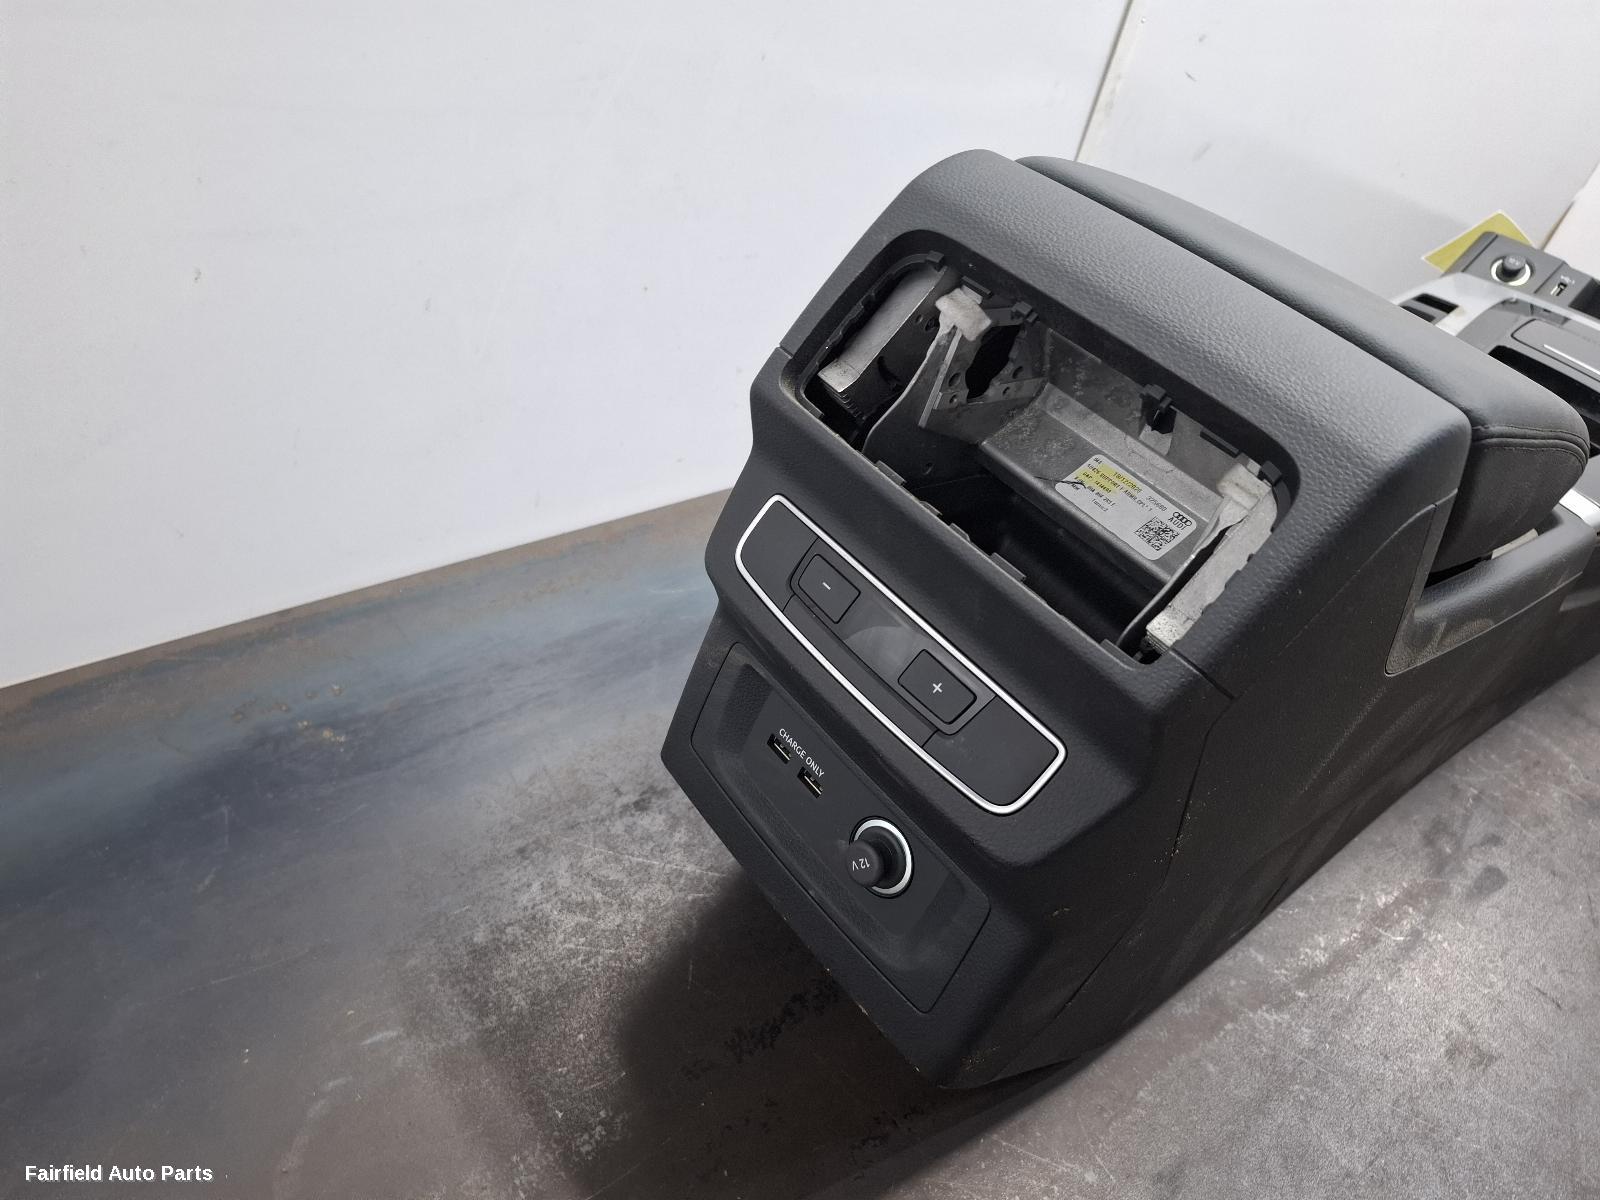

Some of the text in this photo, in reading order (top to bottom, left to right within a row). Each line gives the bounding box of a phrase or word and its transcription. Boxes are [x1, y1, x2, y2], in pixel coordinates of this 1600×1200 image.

[1168, 516, 1188, 531] AUDI
[779, 728, 825, 778] CHARGE ONLY
